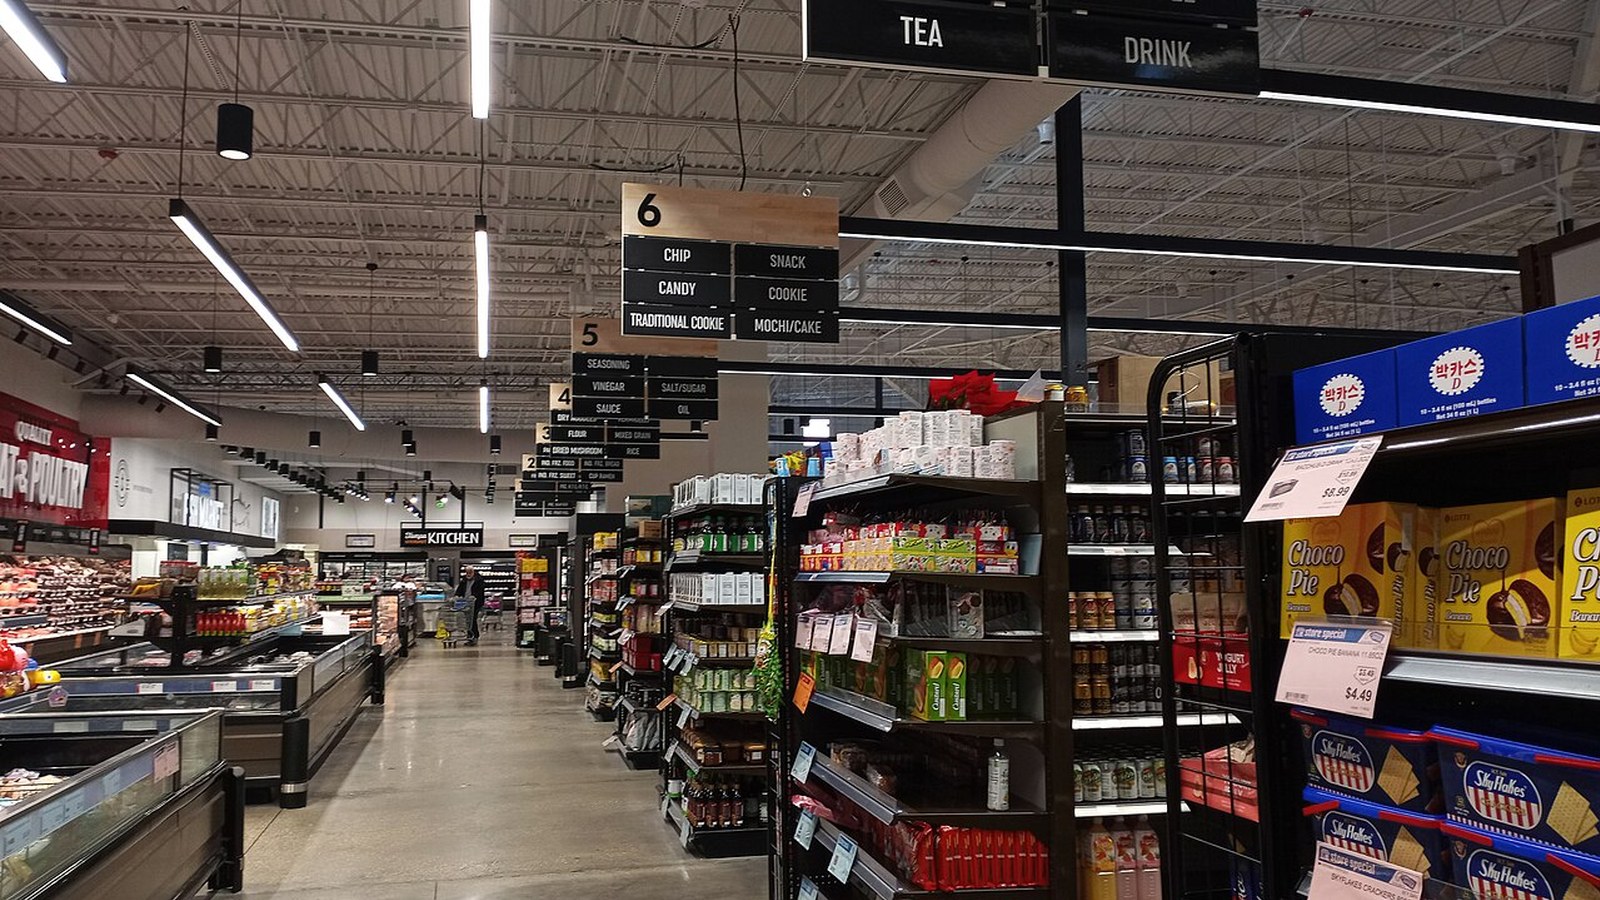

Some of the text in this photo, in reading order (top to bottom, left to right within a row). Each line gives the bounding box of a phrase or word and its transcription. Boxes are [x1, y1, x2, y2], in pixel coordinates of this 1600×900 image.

[900, 16, 944, 47] TEA
[1124, 36, 1192, 68] DRINK
[637, 193, 662, 227] 6
[664, 248, 691, 262] CHIP
[770, 254, 806, 269] SNACK
[658, 281, 697, 296] CANDY
[768, 287, 808, 302] COOKIE
[630, 312, 725, 330] TRADITIONAL COOKIE
[754, 318, 822, 334] MOCHI/CAKE
[581, 323, 598, 346] 5
[587, 358, 630, 370] SEASONING
[1436, 359, 1477, 379] 박카스
[592, 381, 626, 392] VINEGAR
[661, 382, 707, 393] SALT/SUGAR
[1452, 378, 1462, 390] D
[558, 388, 571, 405] 4
[1325, 384, 1359, 402] 박카스
[596, 403, 622, 414] SAUCE
[677, 405, 690, 414] OIL
[1338, 401, 1346, 412] D
[527, 457, 535, 468] 2
[26, 451, 88, 509] POULTRY
[1322, 486, 1350, 498] $8.99
[428, 532, 479, 544] KITCHEN
[1287, 539, 1346, 567] Choco
[1445, 540, 1510, 571] Choco
[1287, 568, 1319, 597] Pie
[1445, 572, 1481, 603] Pie
[1303, 628, 1322, 637] store
[1322, 628, 1347, 640] special
[1215, 652, 1245, 664] YGURT
[1216, 662, 1238, 674] JLLY
[1345, 687, 1372, 702] $4.49
[1330, 852, 1349, 867] store
[1349, 859, 1376, 875] special
